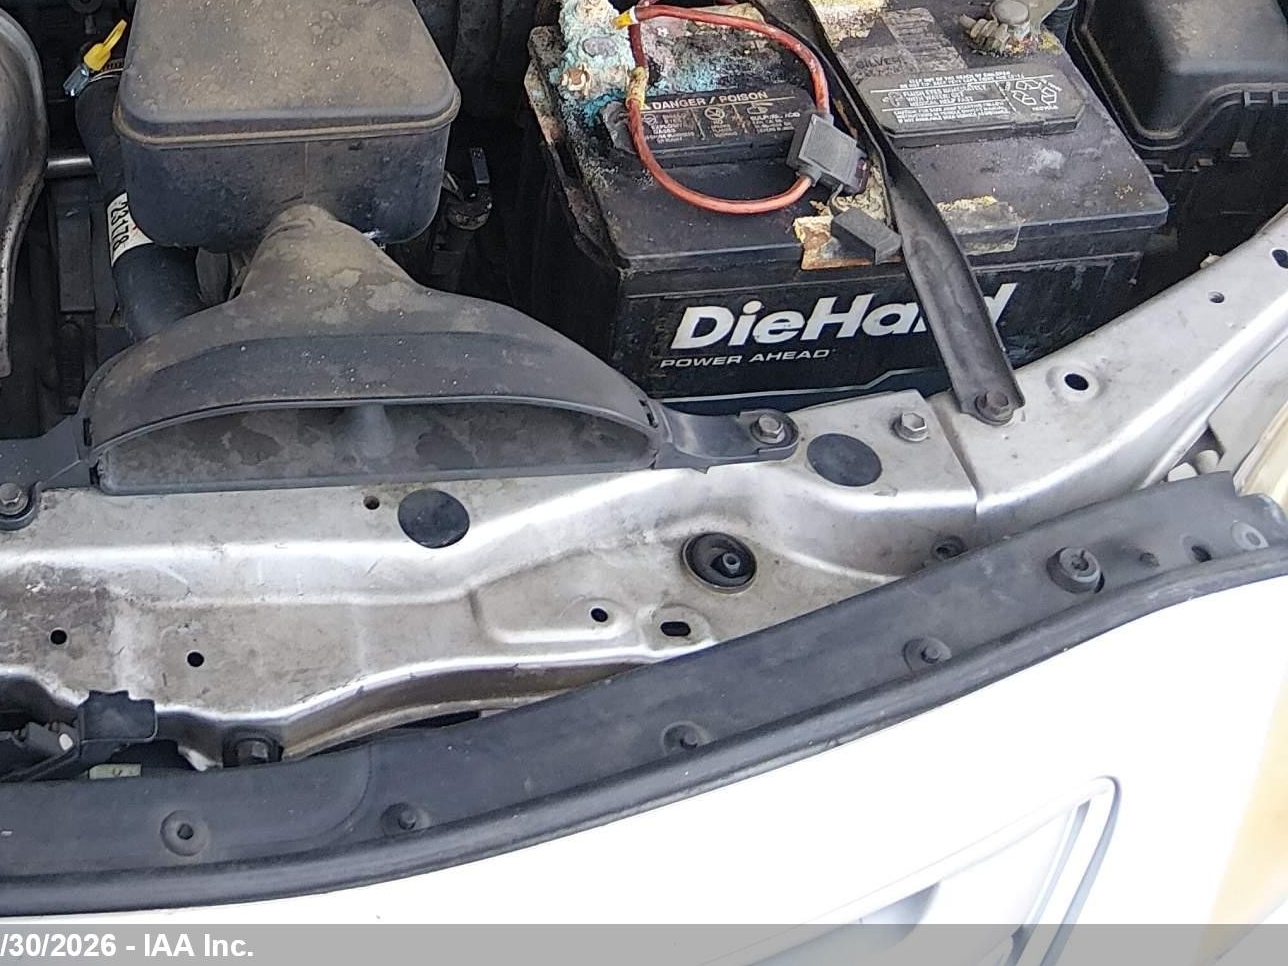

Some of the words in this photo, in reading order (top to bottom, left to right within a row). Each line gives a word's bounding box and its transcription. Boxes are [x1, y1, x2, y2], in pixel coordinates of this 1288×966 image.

[652, 97, 706, 110] DANGER
[720, 91, 768, 104] POISON
[670, 283, 1017, 350] DieHa
[661, 354, 743, 369] POWER
[749, 349, 831, 364] AHEAD
